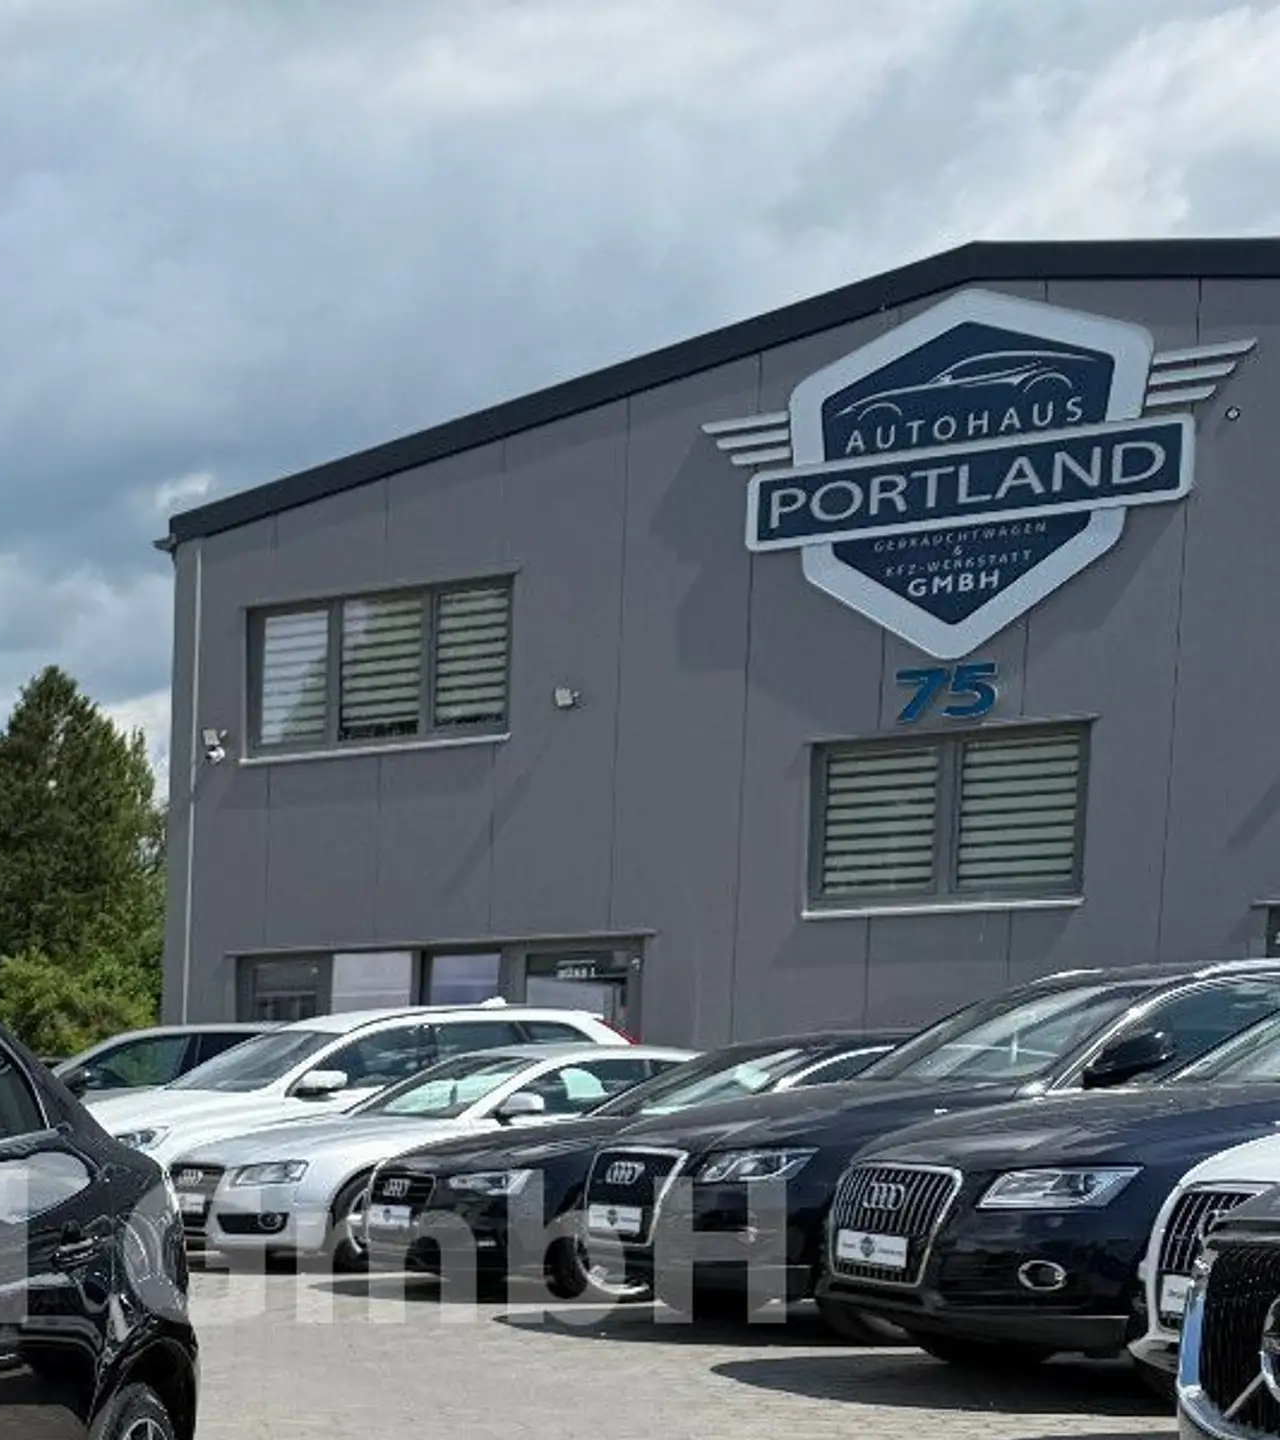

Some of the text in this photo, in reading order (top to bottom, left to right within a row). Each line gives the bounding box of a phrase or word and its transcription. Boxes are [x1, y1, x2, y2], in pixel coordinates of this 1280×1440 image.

[846, 396, 1083, 454] AUTOHAUS
[769, 440, 1166, 529] PORTLAND
[908, 569, 1000, 596] GMBH
[896, 662, 999, 724] 75
